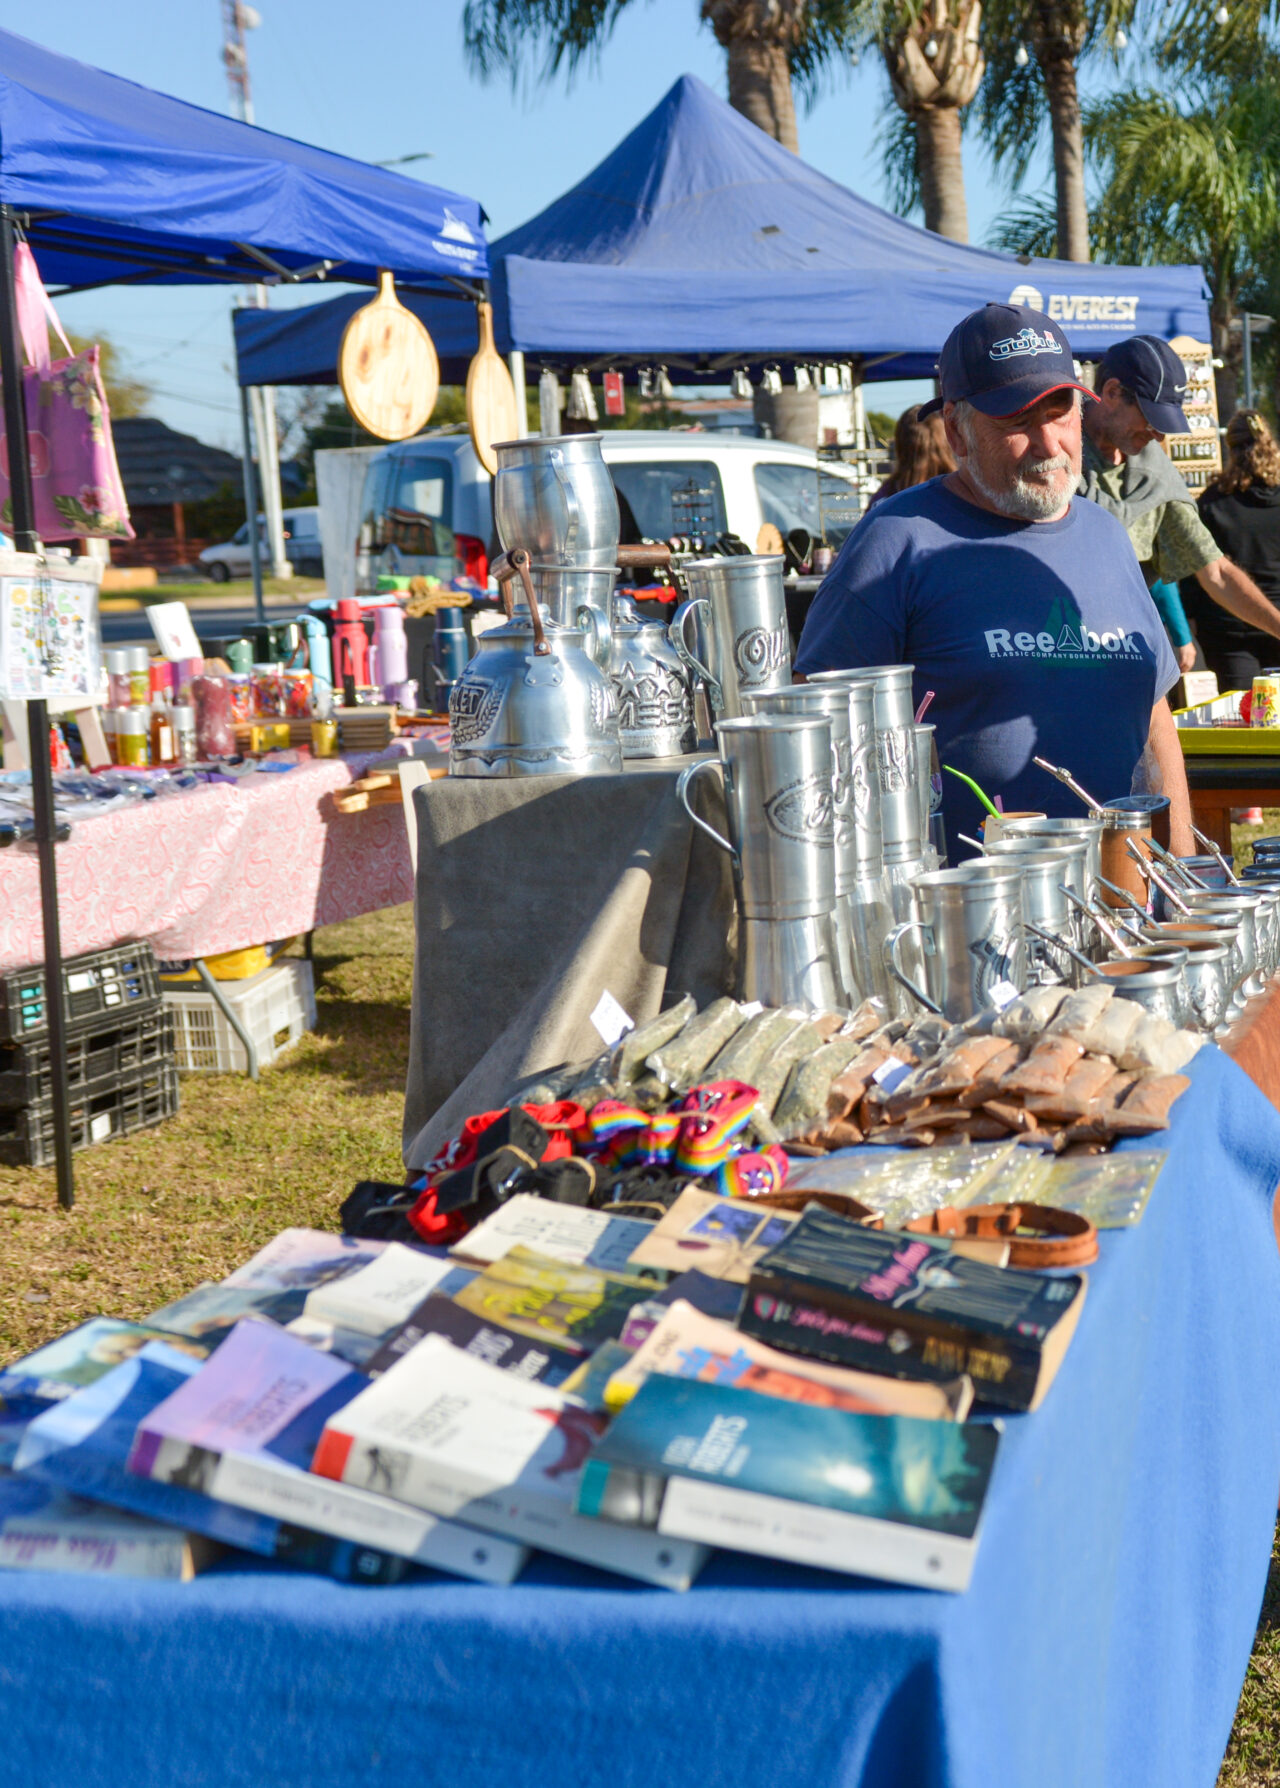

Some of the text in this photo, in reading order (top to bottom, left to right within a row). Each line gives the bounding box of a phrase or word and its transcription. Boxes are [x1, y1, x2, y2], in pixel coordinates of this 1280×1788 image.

[1047, 294, 1140, 321] EVEREST
[984, 624, 1141, 654] Reebok
[990, 651, 1029, 659] CLASSIC
[1031, 651, 1068, 659] COMPANY
[1069, 652, 1090, 660] BORN
[1114, 653, 1129, 661] THE
